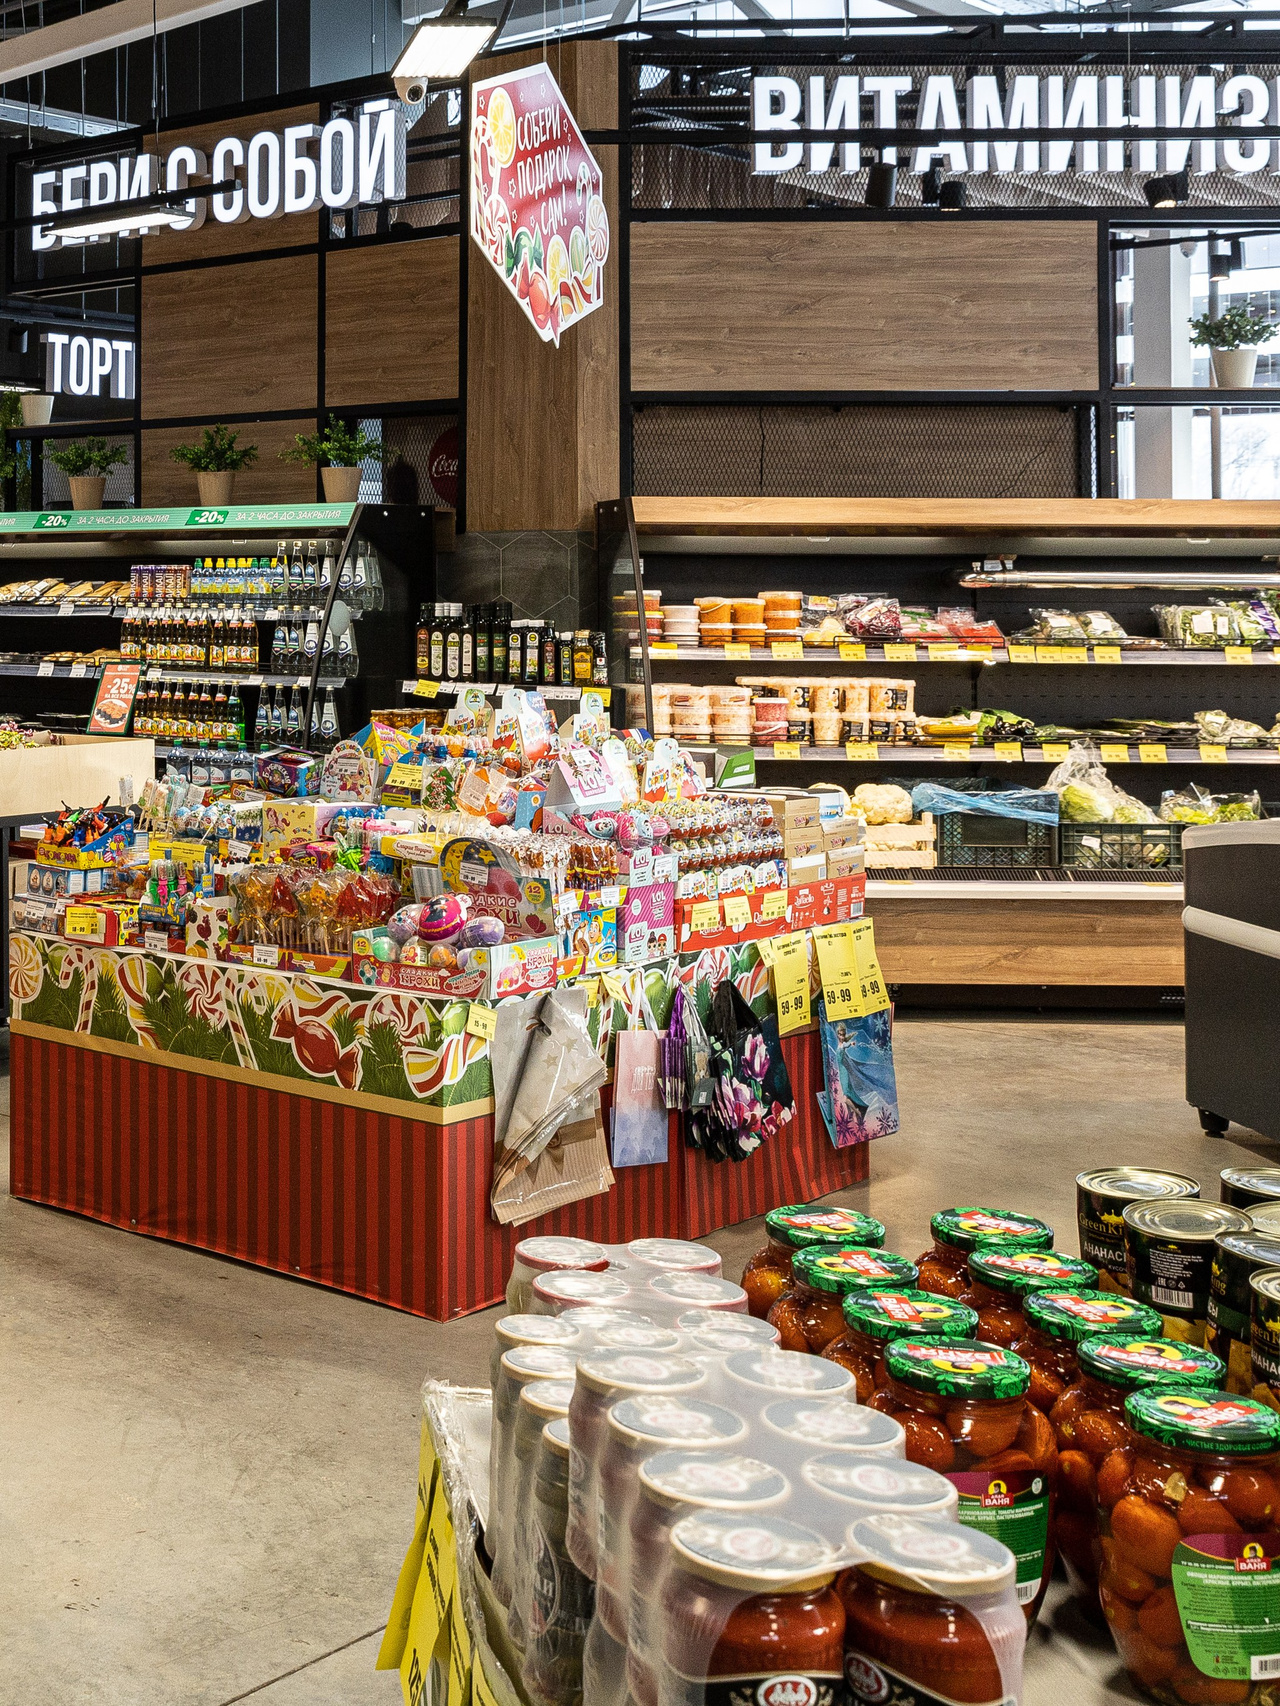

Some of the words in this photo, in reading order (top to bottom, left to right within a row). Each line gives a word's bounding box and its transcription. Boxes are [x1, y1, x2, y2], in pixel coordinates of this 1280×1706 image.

[516, 103, 562, 151] СОБЕРИ
[753, 74, 1280, 175] ВИТАМИНИЗ
[32, 153, 153, 252] БЕРИ
[166, 145, 200, 232] С
[211, 97, 397, 224] СОБОЙ
[516, 145, 574, 200] ПОДАРОК
[540, 184, 569, 236] САМ!
[47, 332, 136, 400] ТОРТ
[41, 514, 68, 527] -20%
[76, 516, 88, 525] ЗА
[95, 515, 116, 525] ЧАСА
[116, 514, 130, 525] ДО
[129, 513, 170, 524] ЗАКРЫТИЯ
[194, 509, 224, 523] -20%
[235, 512, 247, 521] ЗА
[255, 511, 276, 521] ЧАСА
[276, 510, 290, 521] ДО
[289, 509, 342, 521] ЗАКРЫТИЯ
[106, 677, 137, 695] -25%
[548, 824, 569, 834] LOL
[635, 854, 650, 865] LOL
[526, 884, 541, 895] 12
[650, 889, 667, 903] LOL
[630, 927, 646, 940] LOL
[356, 940, 367, 948] 12
[526, 954, 554, 967] КРОХИ
[399, 973, 441, 991] КРОХИ
[826, 987, 852, 1005] 59-99
[780, 994, 804, 1016] 59-99
[473, 1018, 488, 1030] 15-99
[1079, 1212, 1107, 1234] Green
[1107, 1222, 1124, 1236] Ki
[1210, 1278, 1227, 1297] ing
[880, 1297, 909, 1320] ВАНЯ
[1192, 1406, 1246, 1427] ВАНЯ
[1185, 1439, 1214, 1450] ЧИСТЫЕ
[985, 1498, 1010, 1506] ВАНЯ
[1239, 1563, 1267, 1571] ВАНЯ
